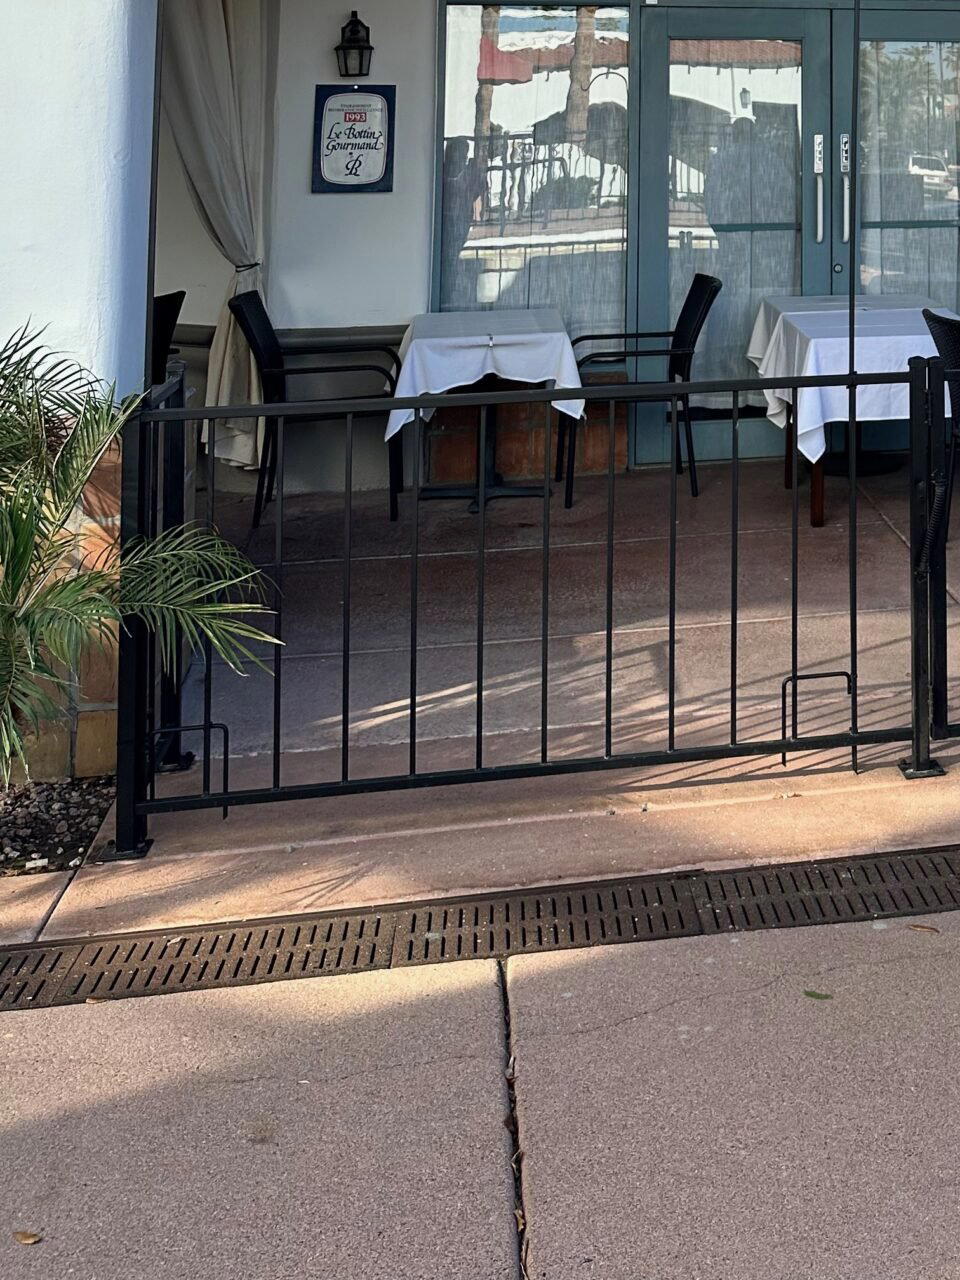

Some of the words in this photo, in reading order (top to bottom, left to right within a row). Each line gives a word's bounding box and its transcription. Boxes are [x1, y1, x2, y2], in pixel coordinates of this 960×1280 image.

[344, 112, 367, 122] 1993
[326, 122, 342, 140] Le
[344, 123, 383, 140] Bottin
[324, 140, 385, 157] Gourmand
